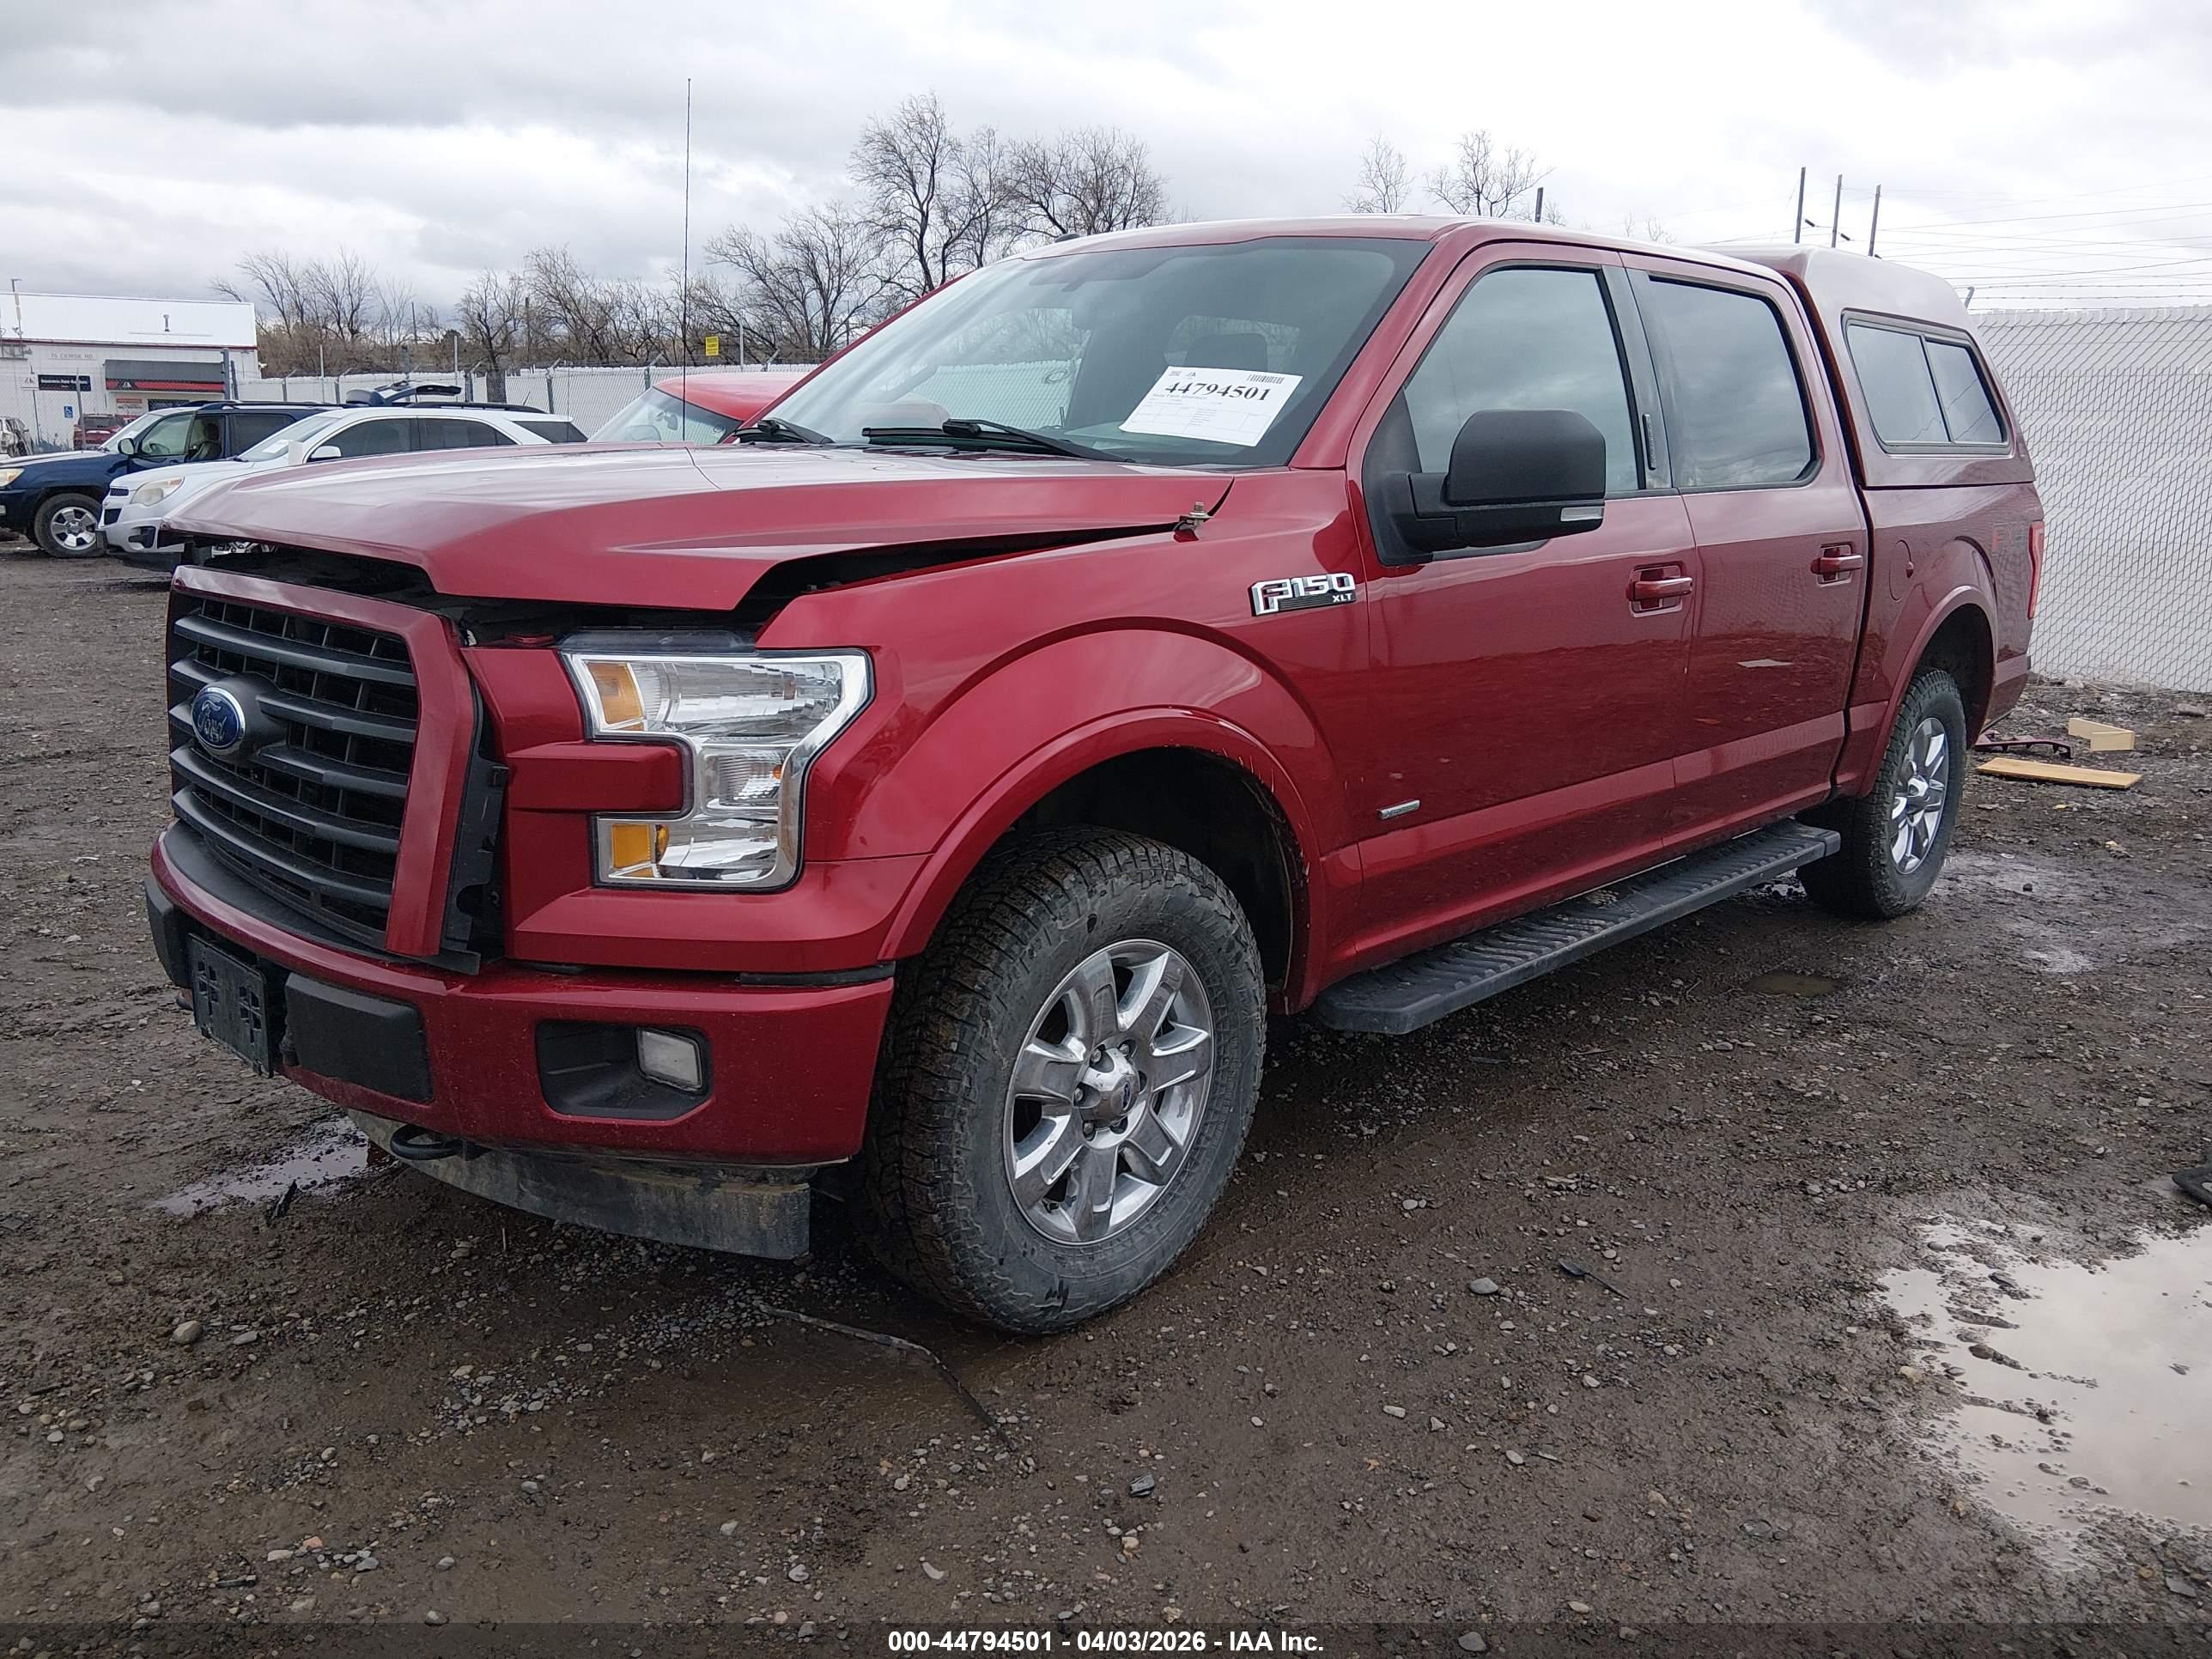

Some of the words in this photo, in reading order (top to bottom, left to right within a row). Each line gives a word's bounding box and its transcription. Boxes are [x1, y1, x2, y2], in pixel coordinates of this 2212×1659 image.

[1165, 381, 1272, 401] 44794501
[1332, 592, 1353, 603] XLT
[197, 700, 228, 743] Ford
